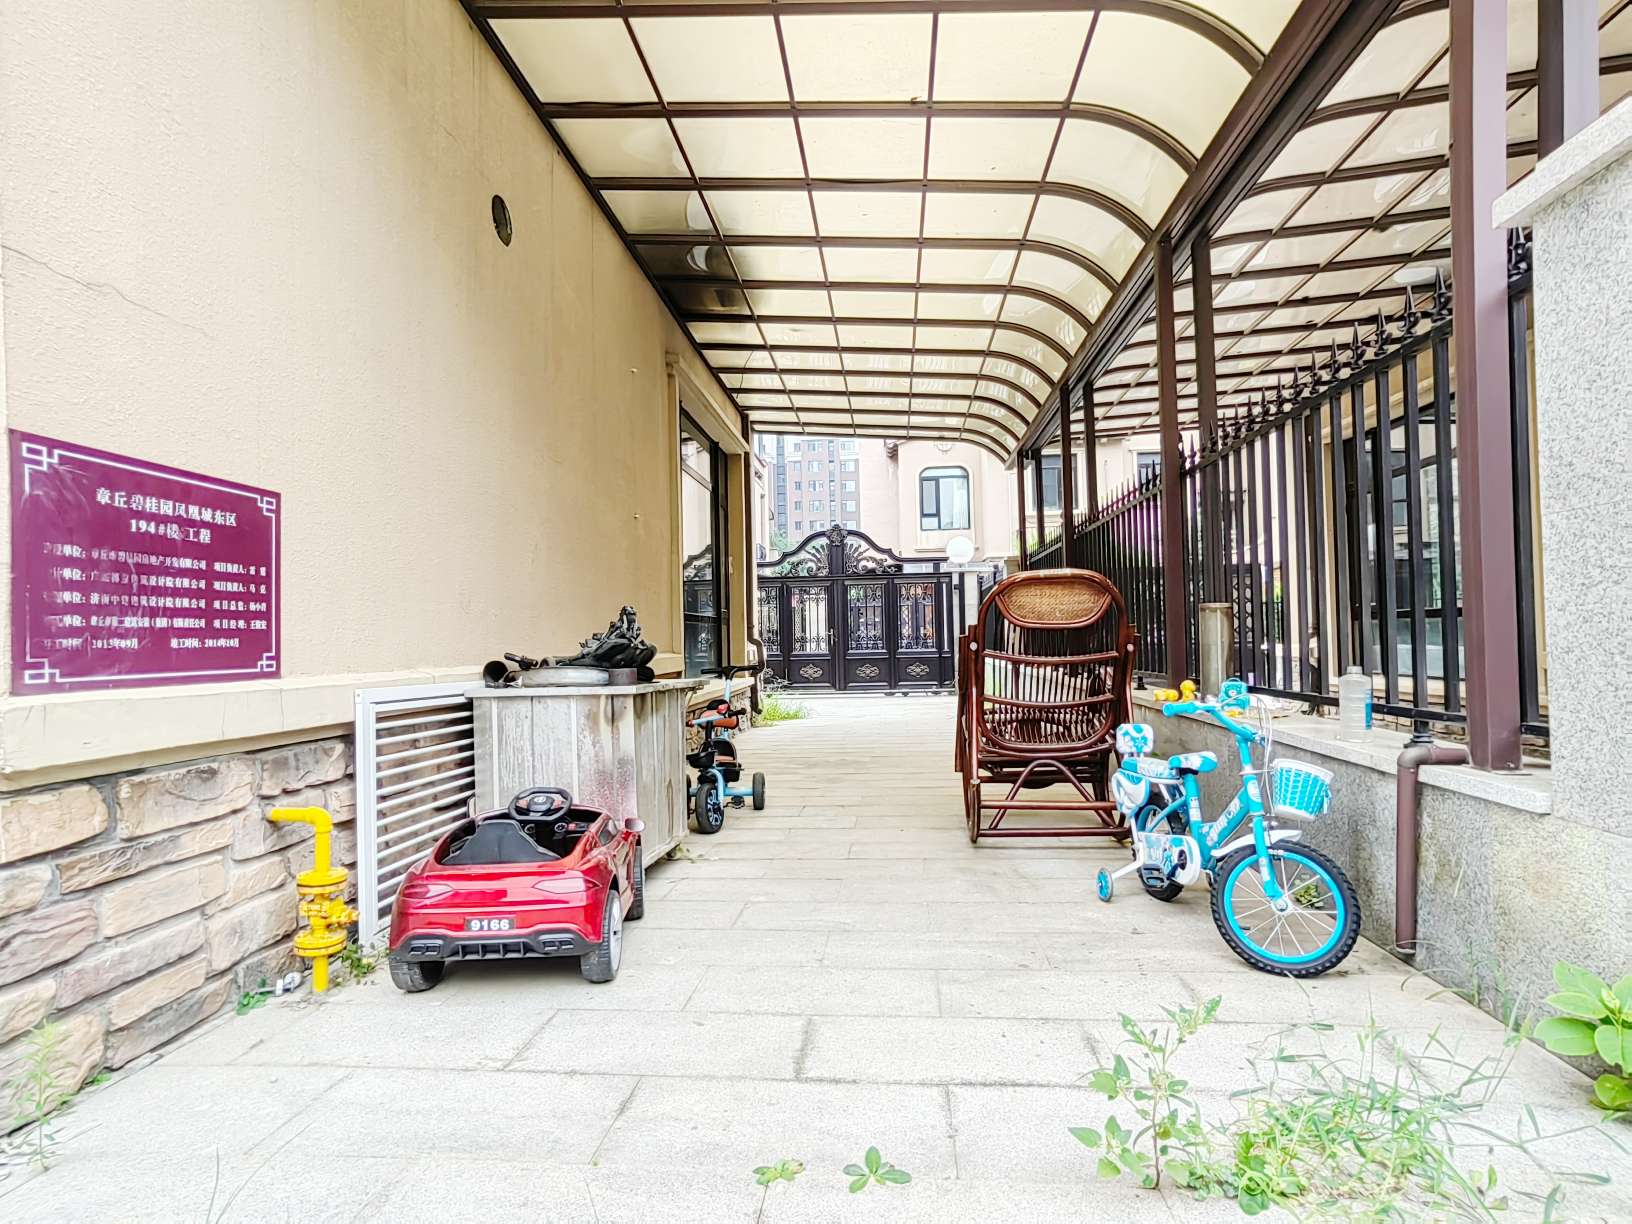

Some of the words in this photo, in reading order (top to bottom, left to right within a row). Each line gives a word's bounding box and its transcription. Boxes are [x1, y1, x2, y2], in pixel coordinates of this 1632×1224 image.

[96, 487, 238, 527] 章丘碧桂园凤凰城东区
[470, 919, 510, 931] 9166
